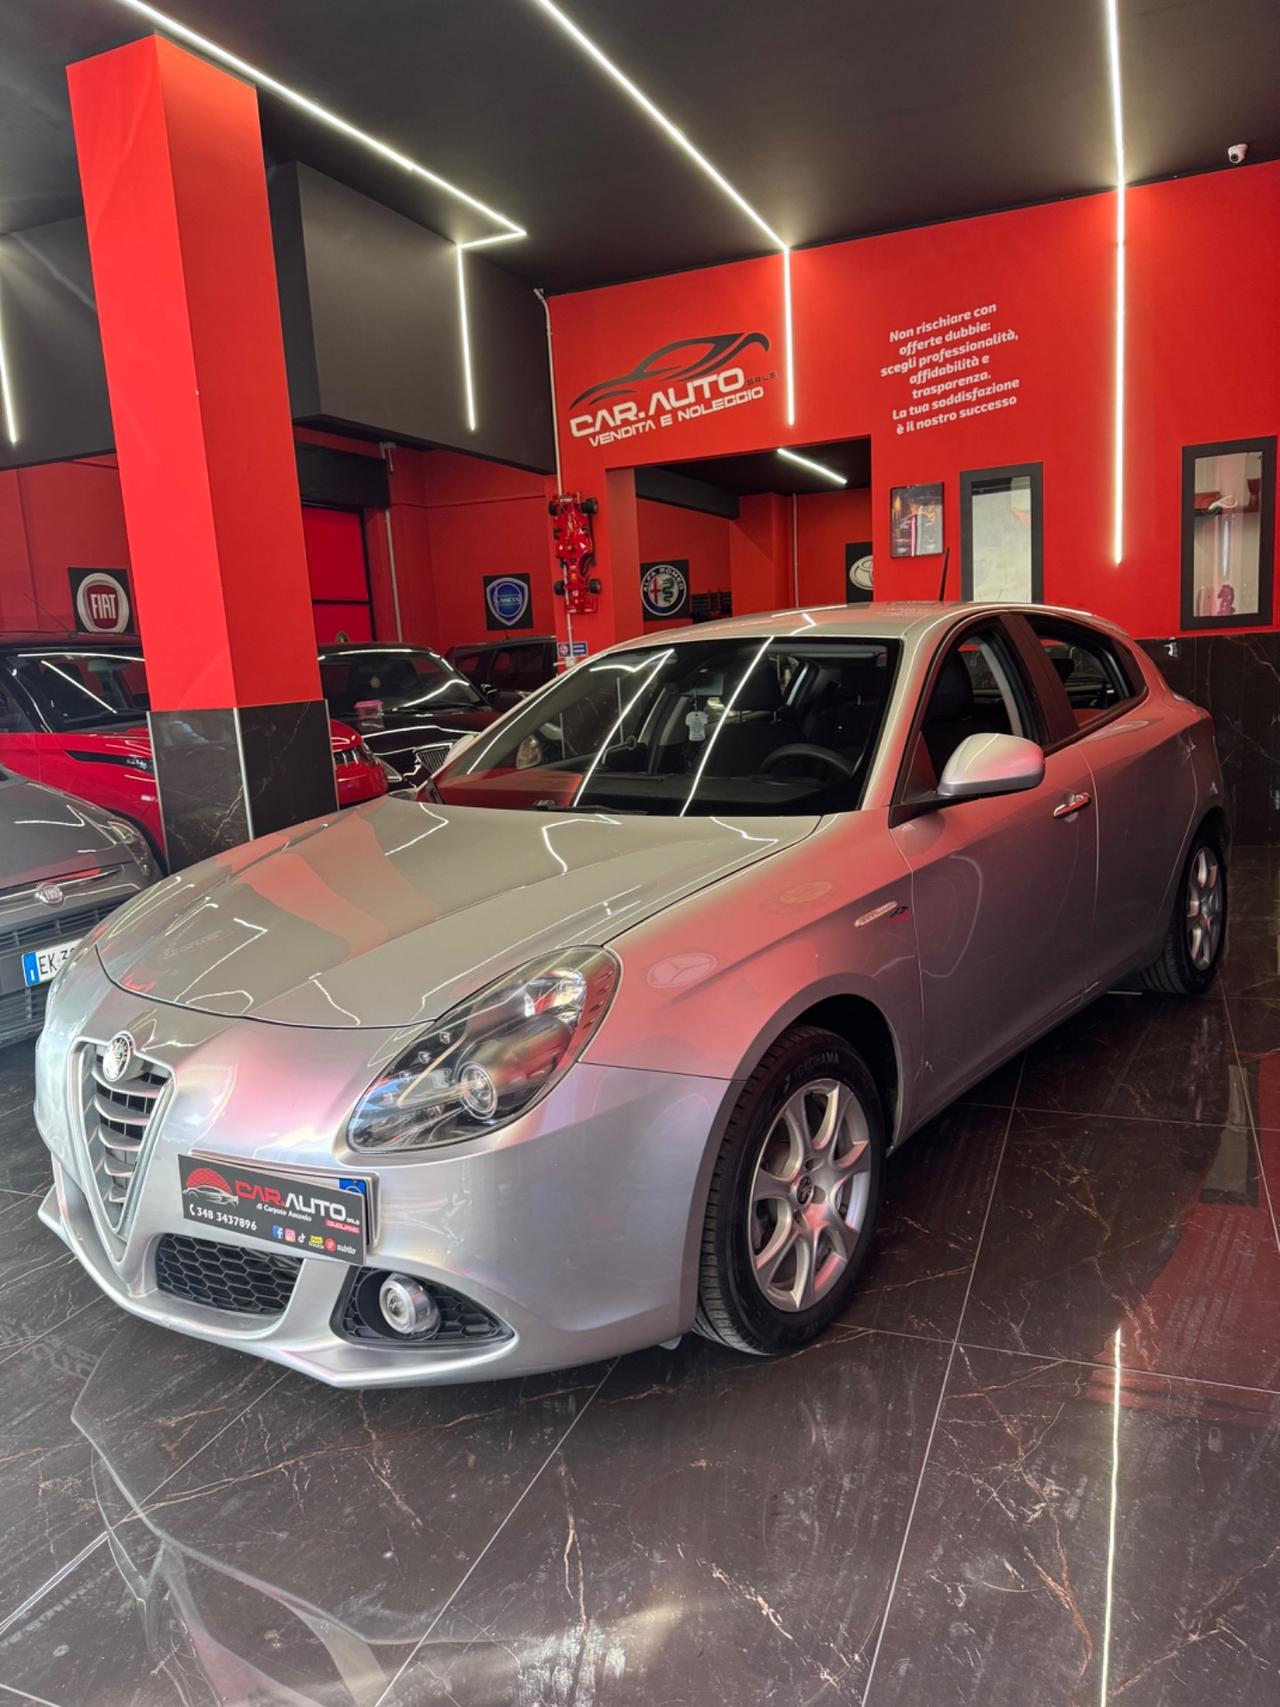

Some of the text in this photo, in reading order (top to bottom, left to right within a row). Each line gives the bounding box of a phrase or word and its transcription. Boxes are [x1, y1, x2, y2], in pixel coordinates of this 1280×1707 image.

[889, 303, 997, 342] Non rischiare con
[899, 322, 991, 356] offerte dubbie:
[880, 329, 1019, 377] scegli professionalità,
[909, 354, 990, 385] affidabilità e
[892, 378, 1020, 421] La tua soddisfazione
[912, 371, 991, 400] trasparenza.
[589, 386, 765, 447] VENDITA E NOLEGGIO
[896, 396, 1017, 435] è il nostro successo
[90, 593, 117, 619] FIAT
[196, 1206, 258, 1232] 348 3437896
